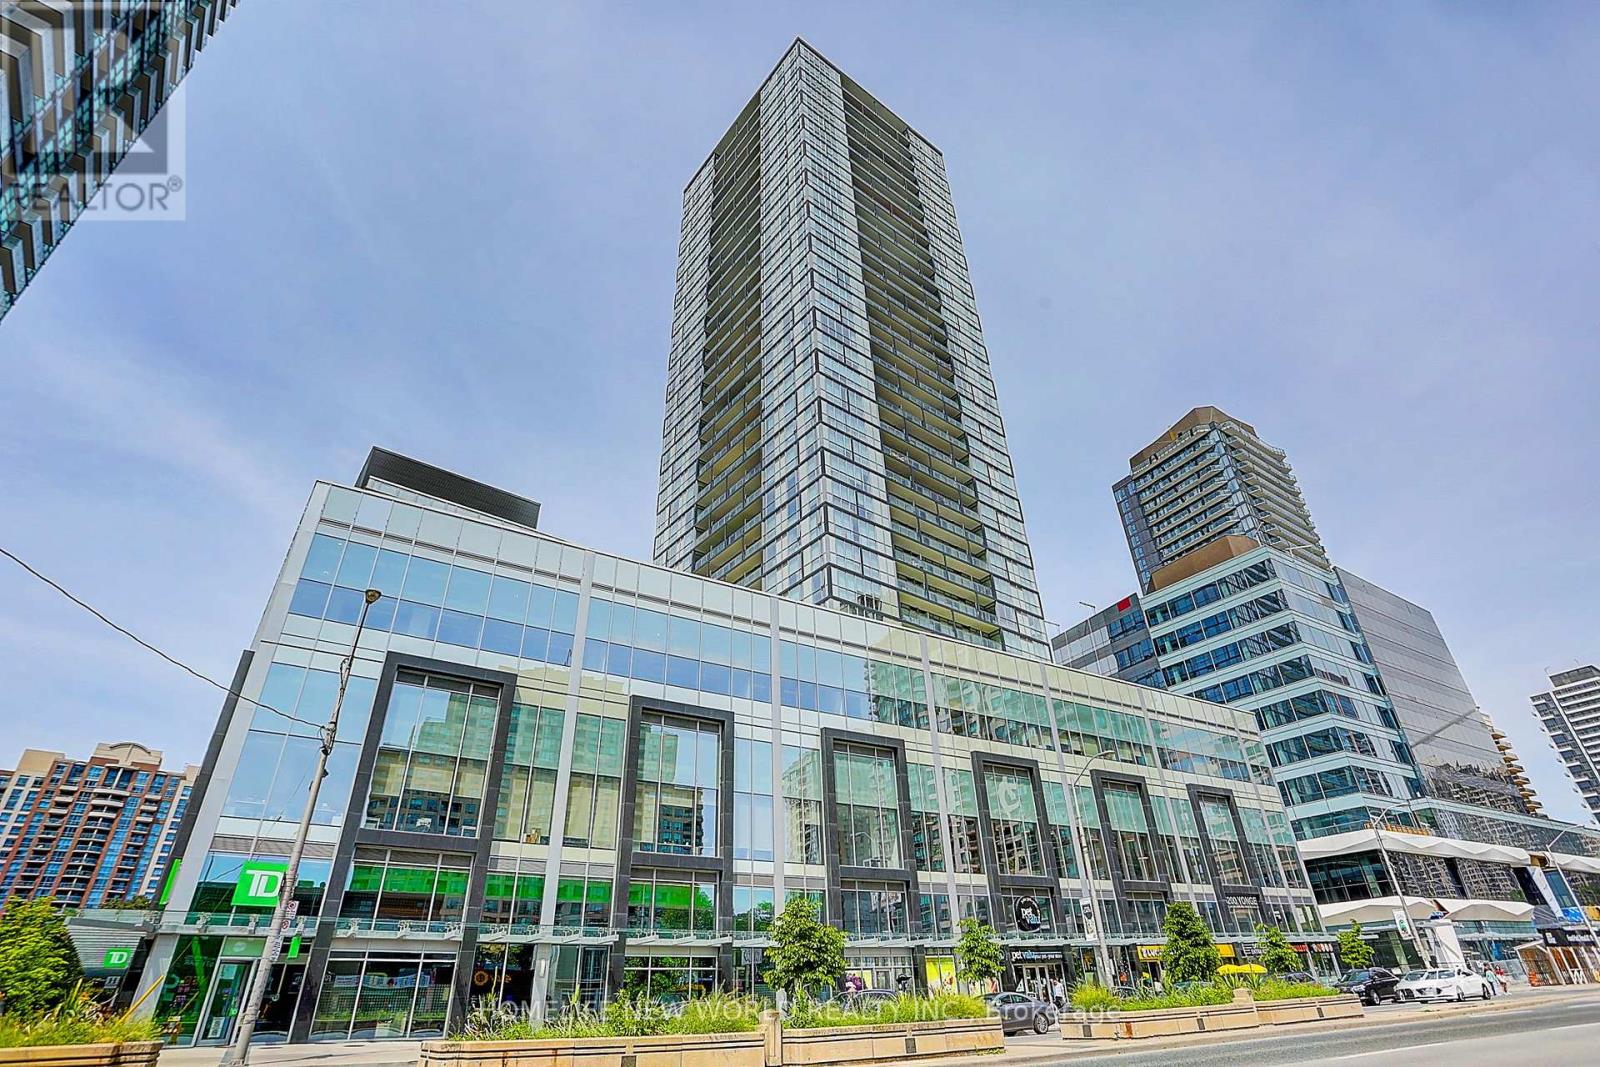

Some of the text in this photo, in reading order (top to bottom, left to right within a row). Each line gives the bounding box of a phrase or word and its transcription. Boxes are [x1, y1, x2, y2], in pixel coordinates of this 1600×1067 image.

[246, 870, 284, 897] TD
[1236, 896, 1258, 906] YONGE
[109, 951, 128, 964] TD
[1011, 950, 1022, 961] pet
